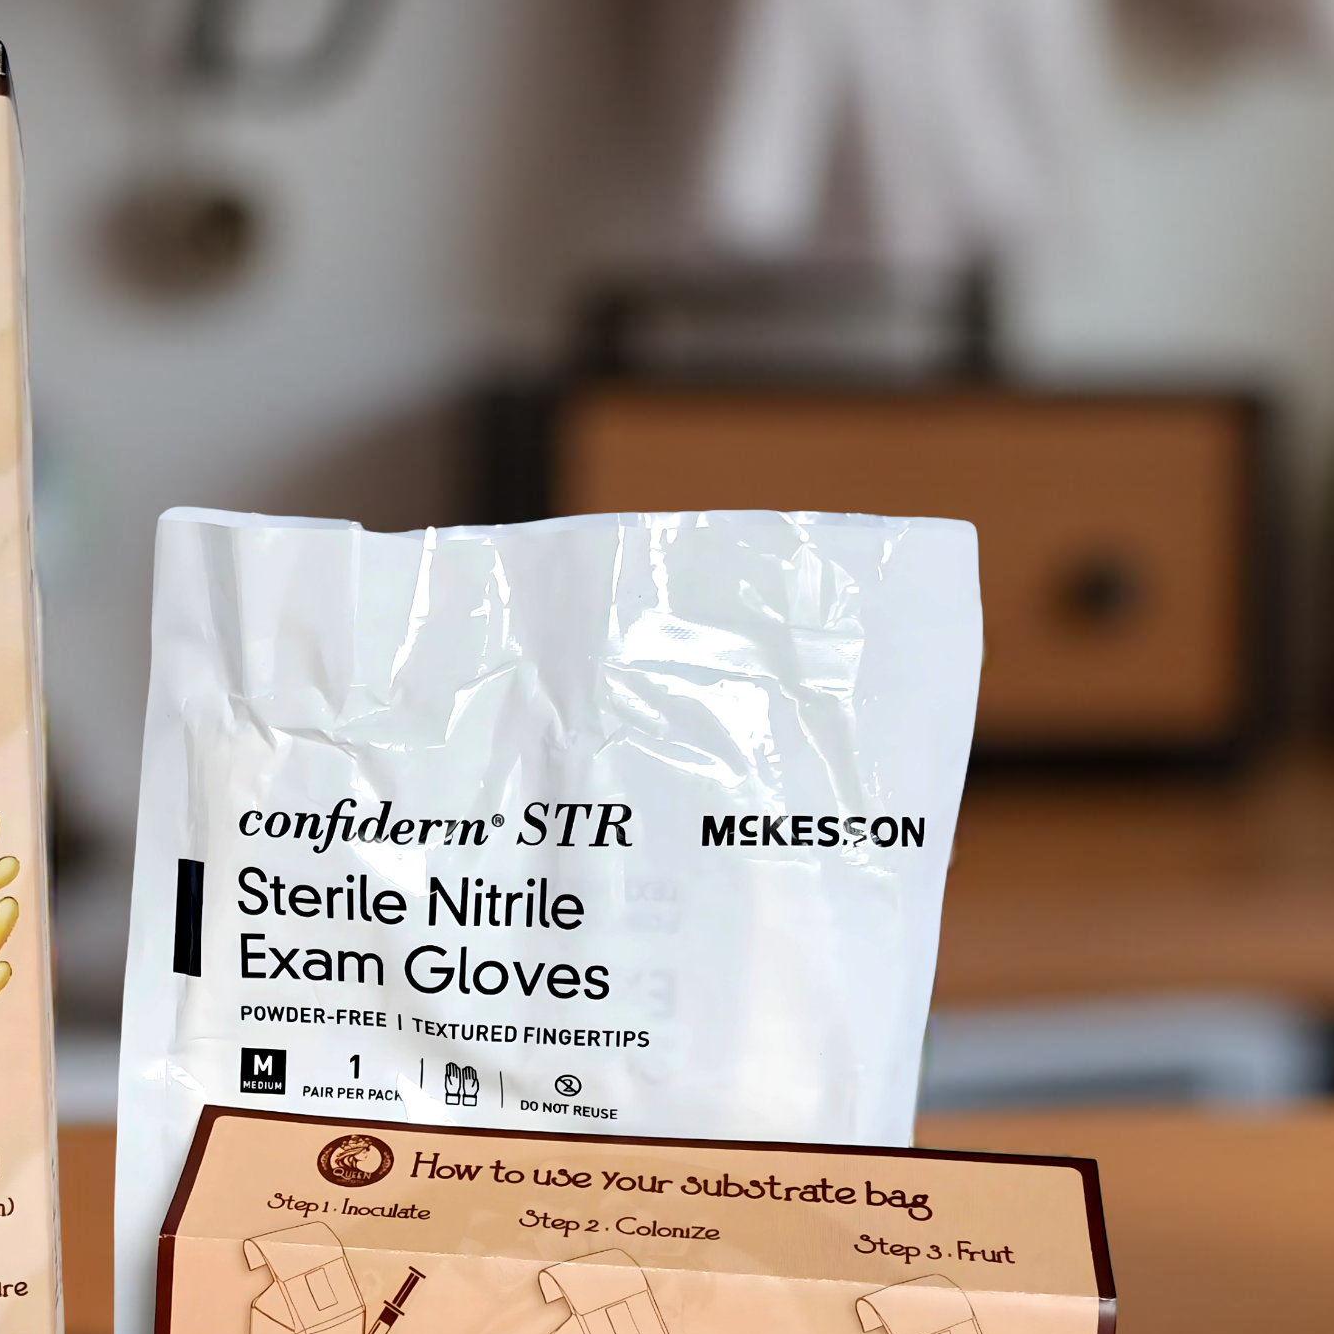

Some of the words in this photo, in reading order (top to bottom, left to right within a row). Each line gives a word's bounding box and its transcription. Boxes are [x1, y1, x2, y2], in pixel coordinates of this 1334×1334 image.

[516, 801, 633, 847] STR
[237, 866, 407, 925] Sterile
[428, 876, 585, 931] Nitrile
[240, 932, 384, 986] Exam
[404, 944, 610, 1001] Gloves
[240, 1005, 387, 1028] POWDER-FREE
[411, 1017, 518, 1043] TEXTURED
[523, 1026, 650, 1048] FINGERTIPS
[254, 1054, 274, 1076] M
[349, 1054, 360, 1080] 1
[243, 1080, 283, 1091] MEDIUM
[302, 1085, 334, 1098] PAIR
[337, 1087, 365, 1100] PER
[520, 1099, 539, 1112] DO
[542, 1102, 570, 1115] NOT
[573, 1105, 618, 1120] REUSE
[333, 1167, 372, 1180] QUEEN
[410, 1151, 484, 1182] How
[489, 1159, 525, 1184] to
[533, 1168, 593, 1189] use
[601, 1171, 674, 1194] your
[680, 1173, 857, 1205] substrate
[864, 1180, 933, 1222] bag
[266, 1192, 319, 1219] Step
[321, 1201, 329, 1213] 1
[341, 1197, 431, 1220] Inoculate
[518, 1209, 581, 1238] Step
[584, 1219, 600, 1233] 2
[615, 1216, 721, 1241] Colonize
[853, 1234, 921, 1265] Step
[926, 1244, 943, 1260] 3
[957, 1240, 1016, 1264] Fruit
